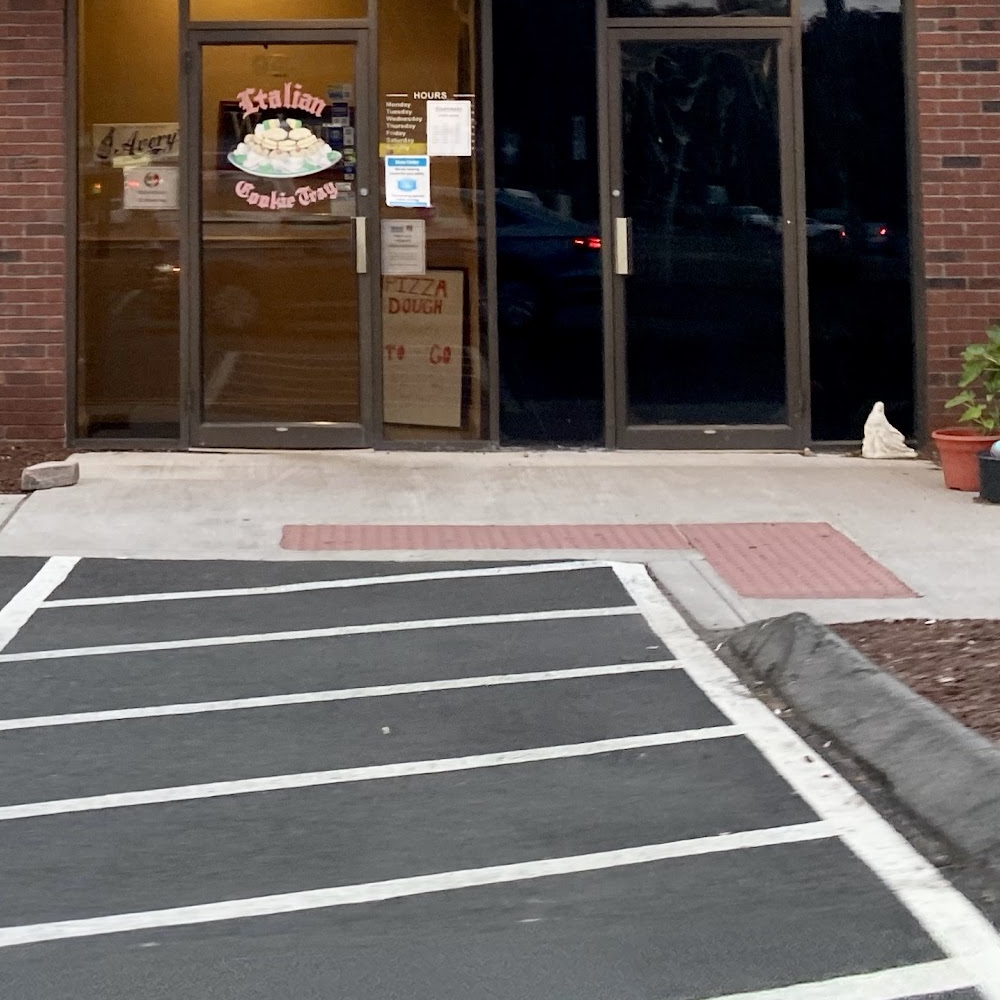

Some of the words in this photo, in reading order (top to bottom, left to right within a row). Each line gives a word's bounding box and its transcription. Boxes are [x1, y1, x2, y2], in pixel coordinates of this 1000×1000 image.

[413, 91, 448, 100] HOURS
[237, 82, 327, 119] Italian
[386, 101, 412, 109] Monday
[386, 108, 413, 116] Tuesday
[386, 122, 416, 130] Thursday
[386, 137, 415, 145] Saturday
[235, 181, 296, 210] Cookie
[295, 181, 338, 206] Tray
[388, 297, 442, 314] DOUGH
[385, 344, 405, 361] TO
[429, 344, 451, 364] GO
